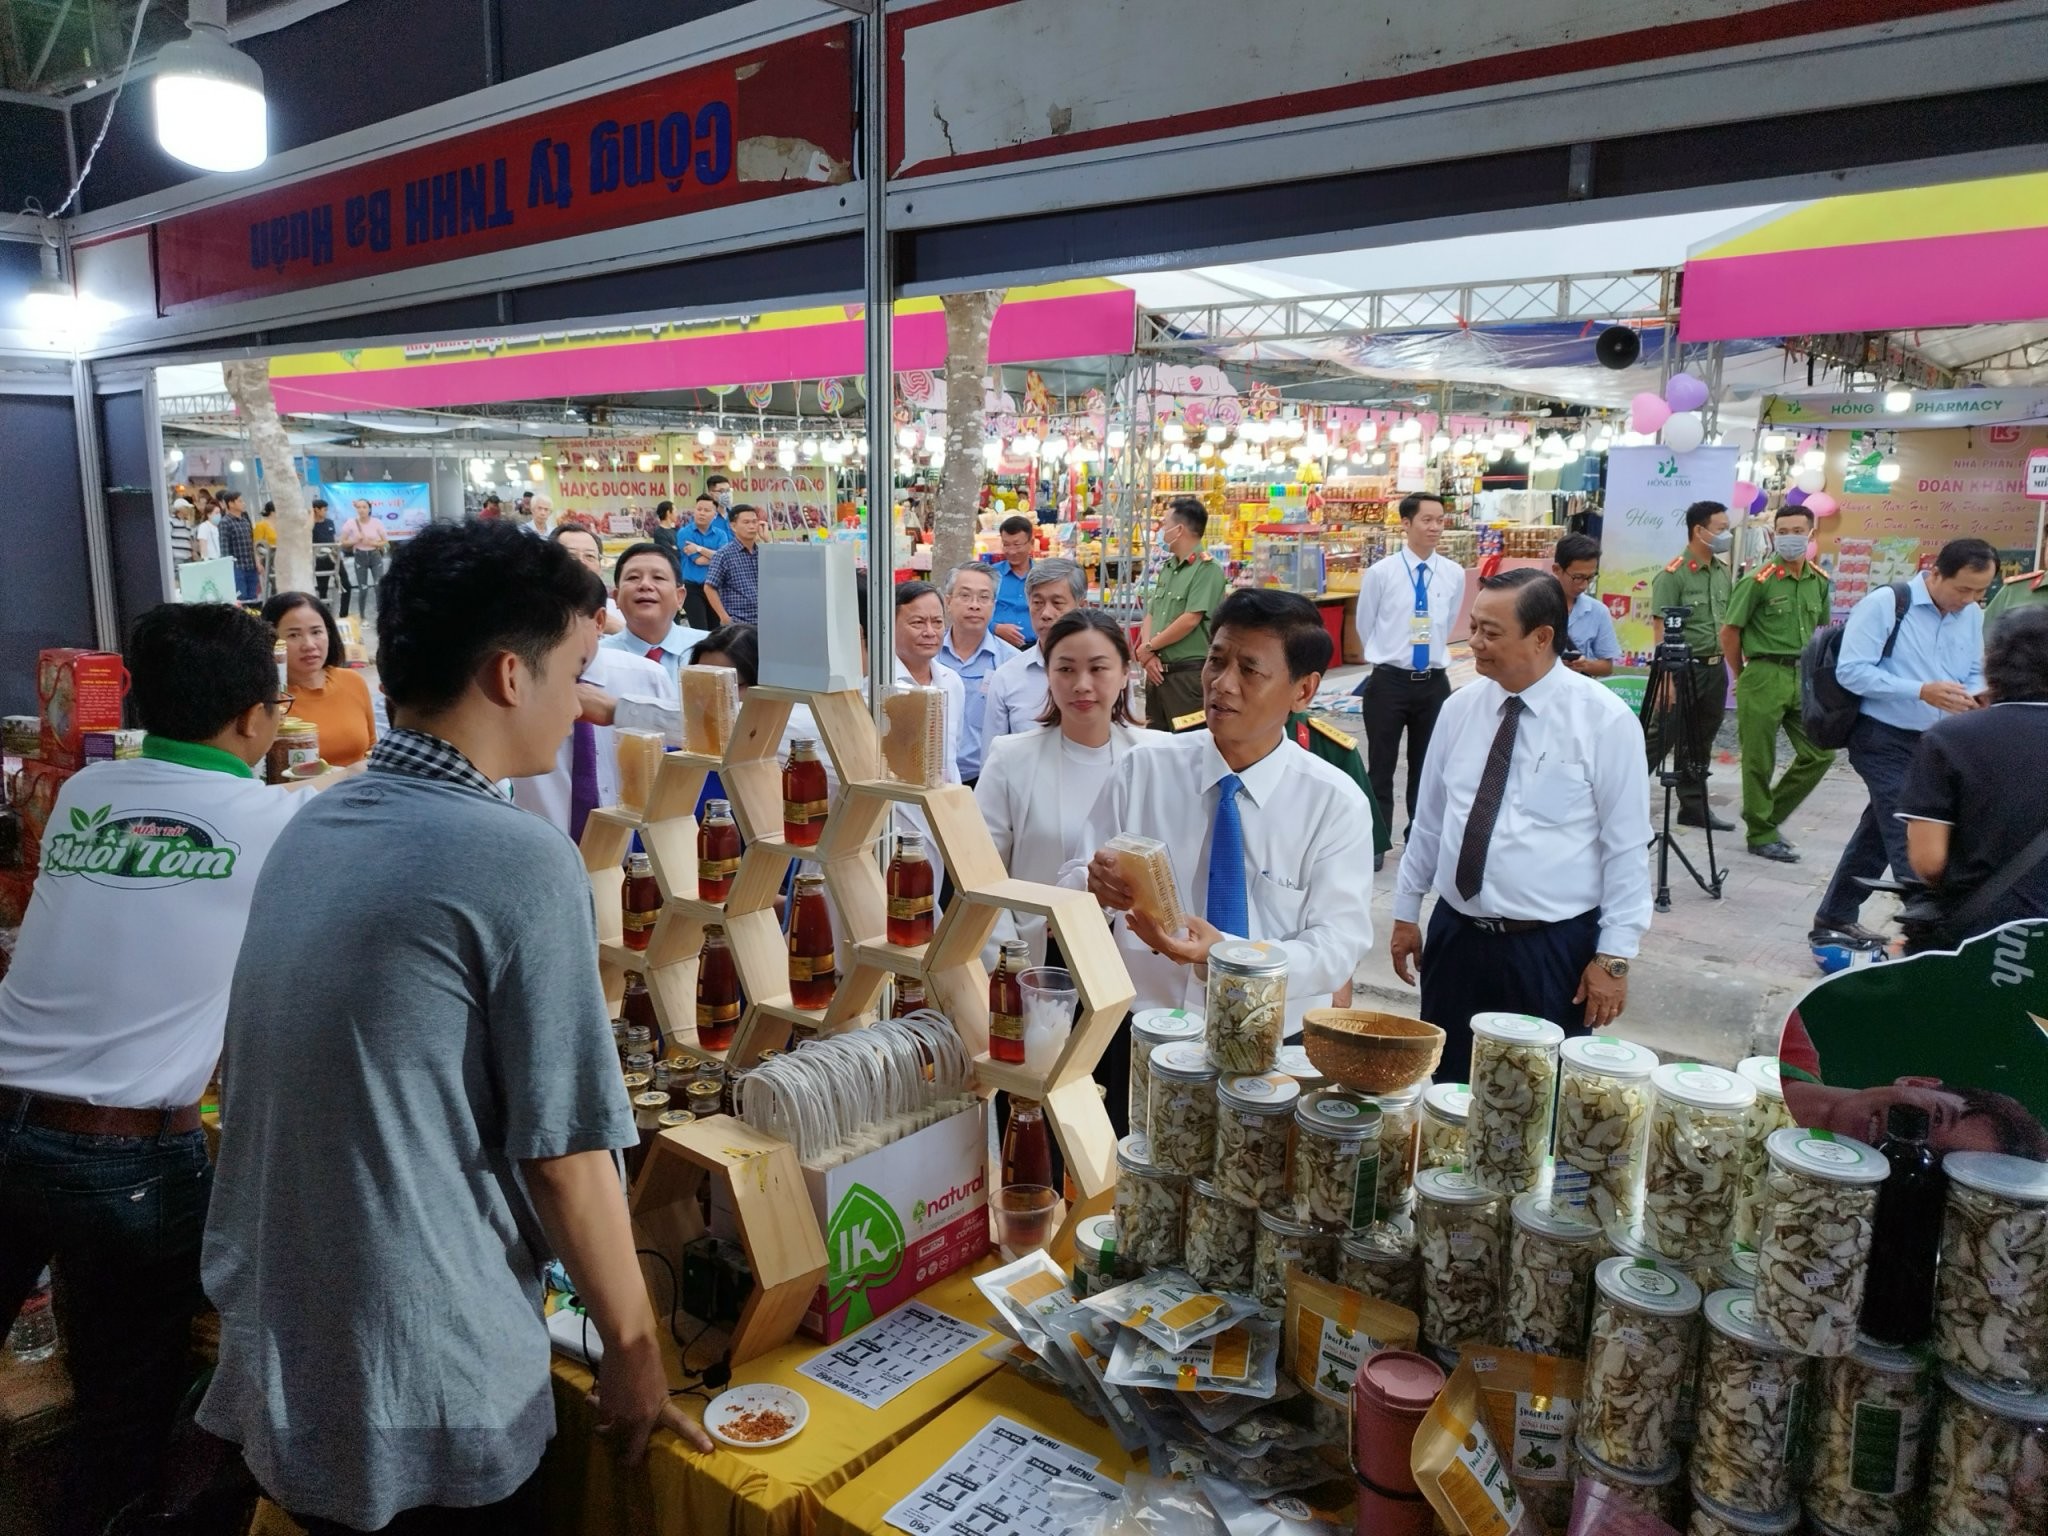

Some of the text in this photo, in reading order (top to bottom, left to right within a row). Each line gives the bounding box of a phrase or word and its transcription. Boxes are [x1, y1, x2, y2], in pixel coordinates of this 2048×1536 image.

[250, 100, 732, 272] Công ty TNHH Ba Huân
[1915, 400, 2003, 413] PHARMACY
[136, 839, 232, 876] Tôm
[927, 1164, 984, 1218] natural
[839, 1217, 890, 1275] IK
[1032, 1434, 1060, 1450] MENU
[1065, 1464, 1096, 1483] MENU
